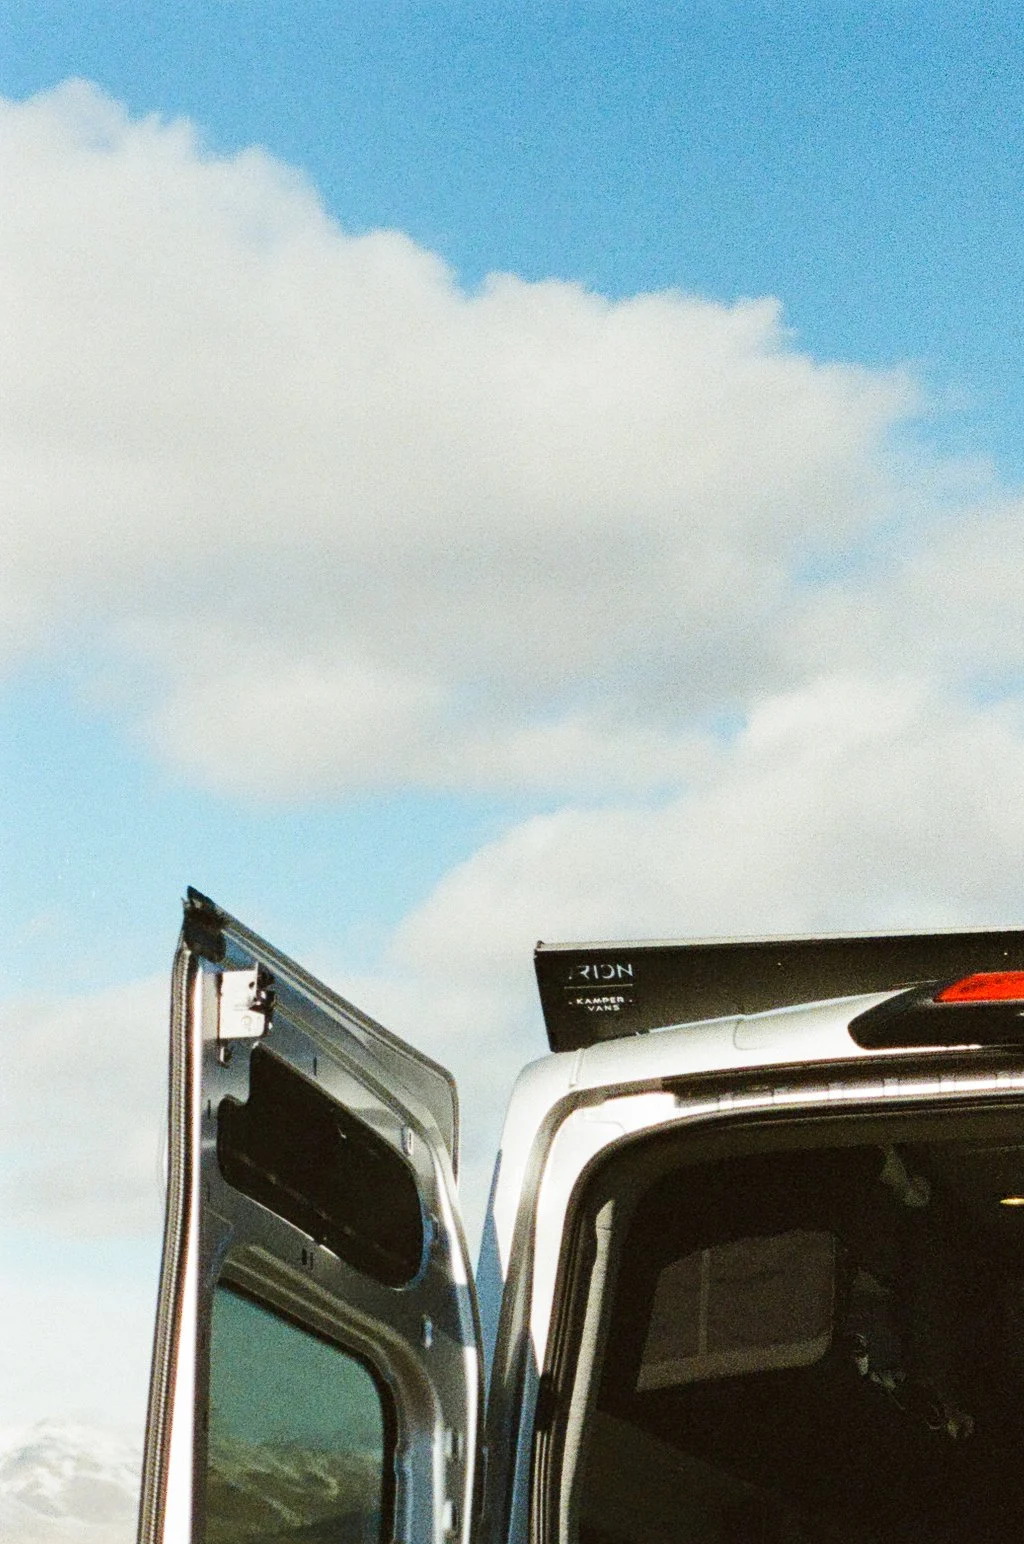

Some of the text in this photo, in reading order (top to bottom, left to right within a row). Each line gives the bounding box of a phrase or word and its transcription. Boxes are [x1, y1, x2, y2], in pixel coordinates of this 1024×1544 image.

[567, 963, 633, 980] RION
[576, 996, 625, 1005] KAMPER
[587, 1004, 620, 1012] VANS
